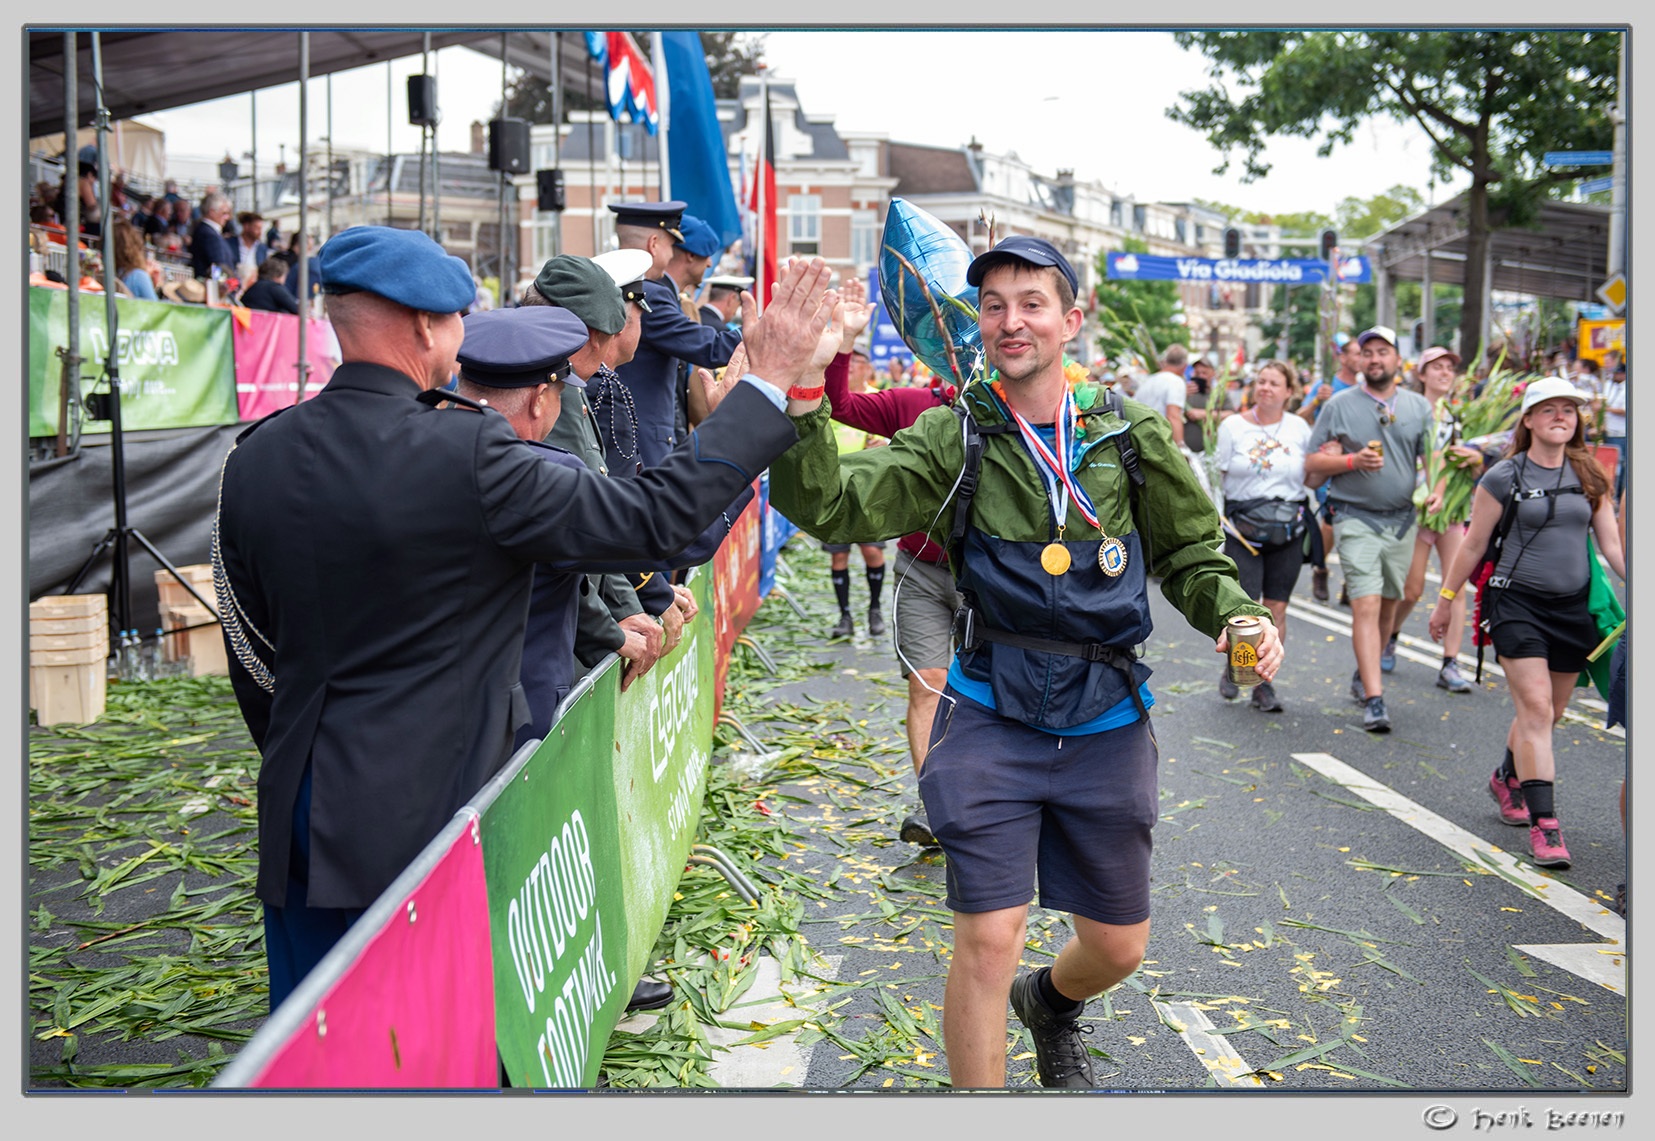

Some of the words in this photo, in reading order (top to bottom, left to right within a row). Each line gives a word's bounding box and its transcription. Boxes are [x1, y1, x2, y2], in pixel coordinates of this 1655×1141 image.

[1176, 259, 1213, 279] Via
[1214, 259, 1303, 281] Gladiola
[1233, 650, 1255, 665] Leffe
[508, 809, 596, 1014] OUTDOOR
